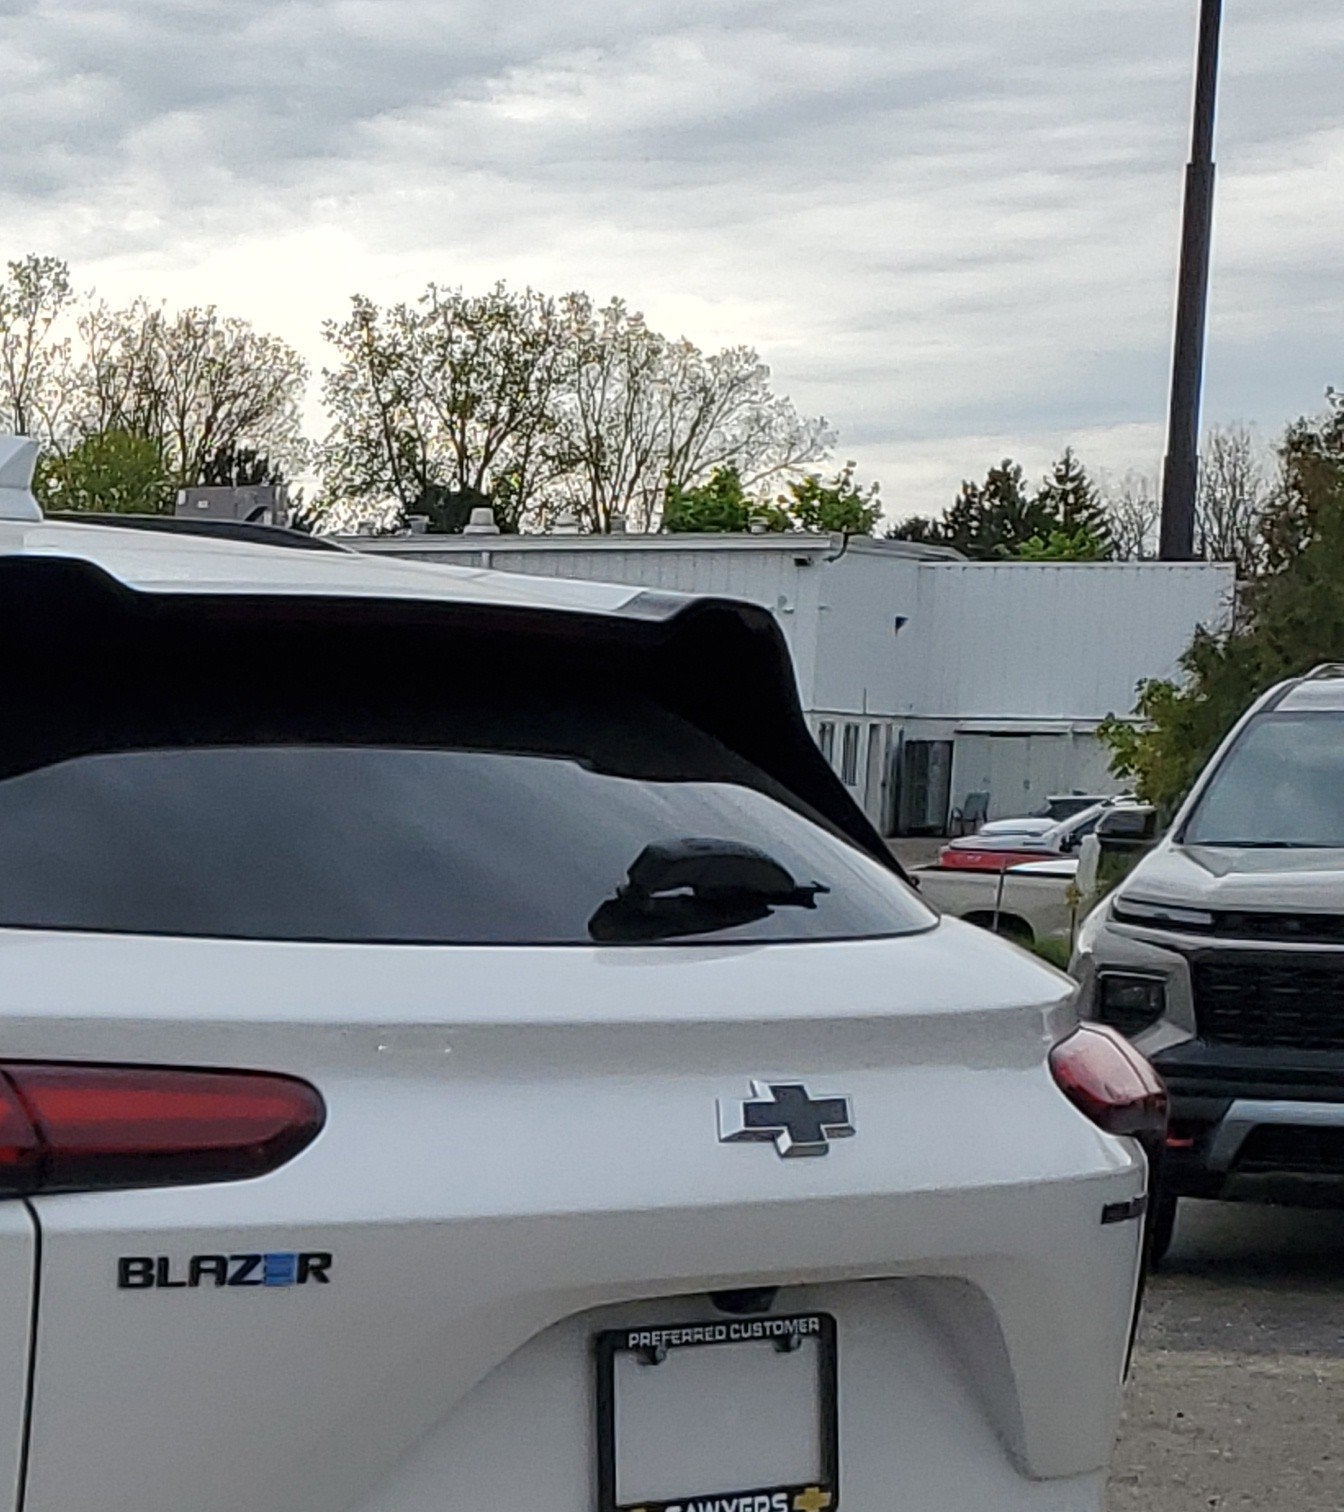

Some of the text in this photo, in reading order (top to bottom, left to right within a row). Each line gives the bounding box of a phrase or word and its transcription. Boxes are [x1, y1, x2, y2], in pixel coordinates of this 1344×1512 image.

[117, 1252, 333, 1288] BLAZER
[628, 1317, 820, 1348] PREFERRED CUSTOMER
